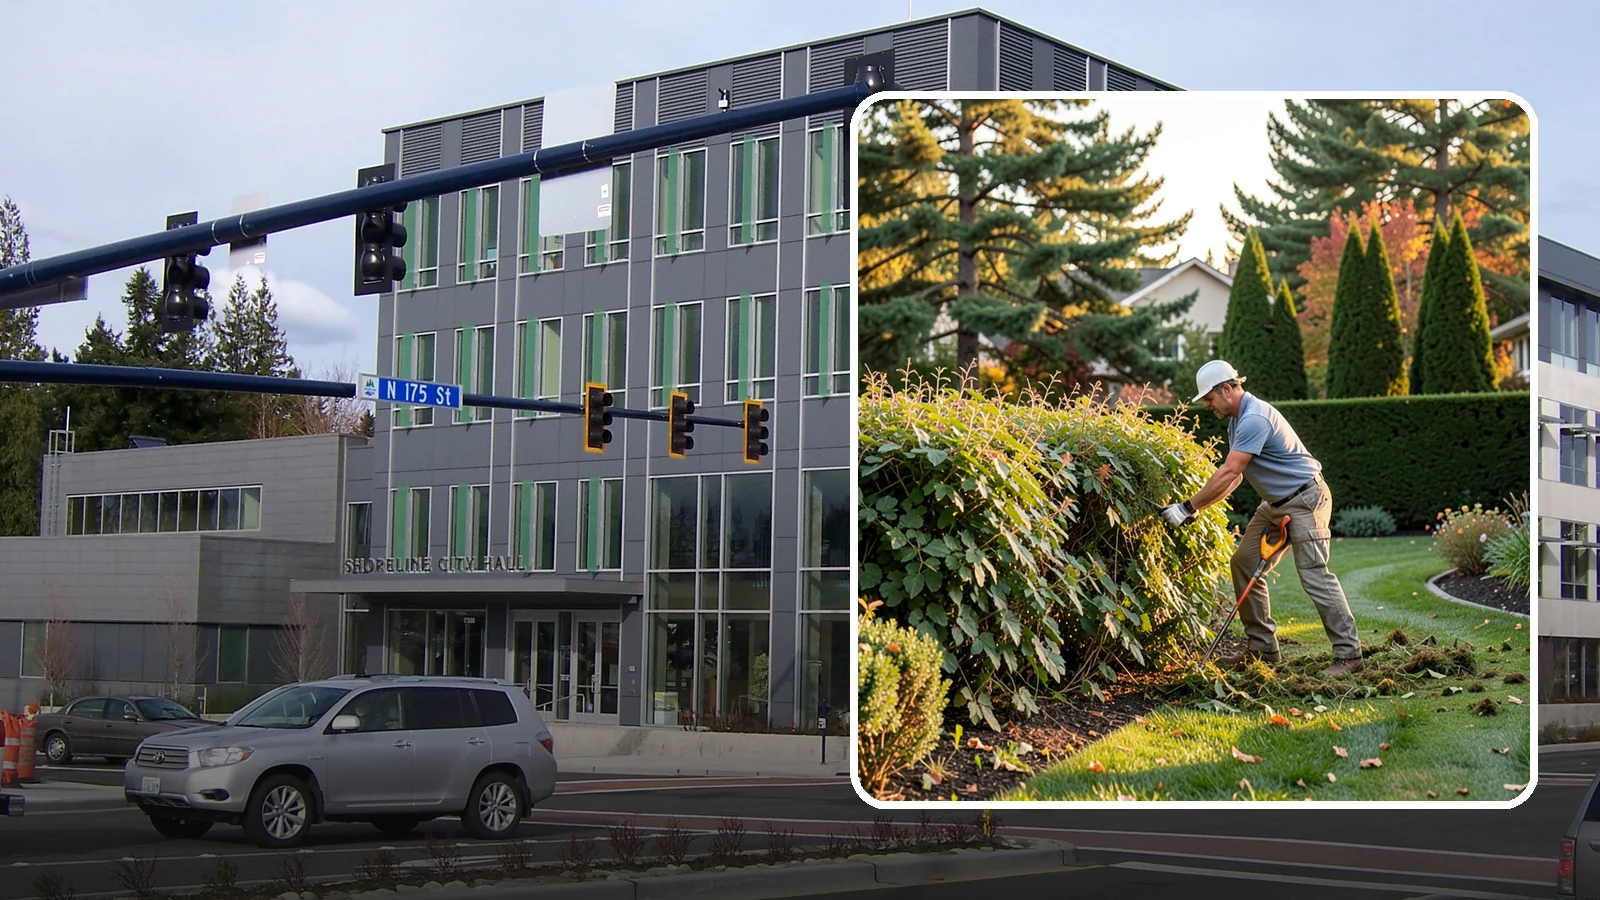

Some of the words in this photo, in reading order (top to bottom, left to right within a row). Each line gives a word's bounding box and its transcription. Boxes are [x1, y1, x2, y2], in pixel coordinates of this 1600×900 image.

[387, 380, 397, 400] N
[405, 382, 427, 403] 175
[436, 386, 451, 406] St
[345, 557, 432, 574] SHORELINE
[438, 556, 475, 572] CITY
[483, 555, 525, 571] HALL
